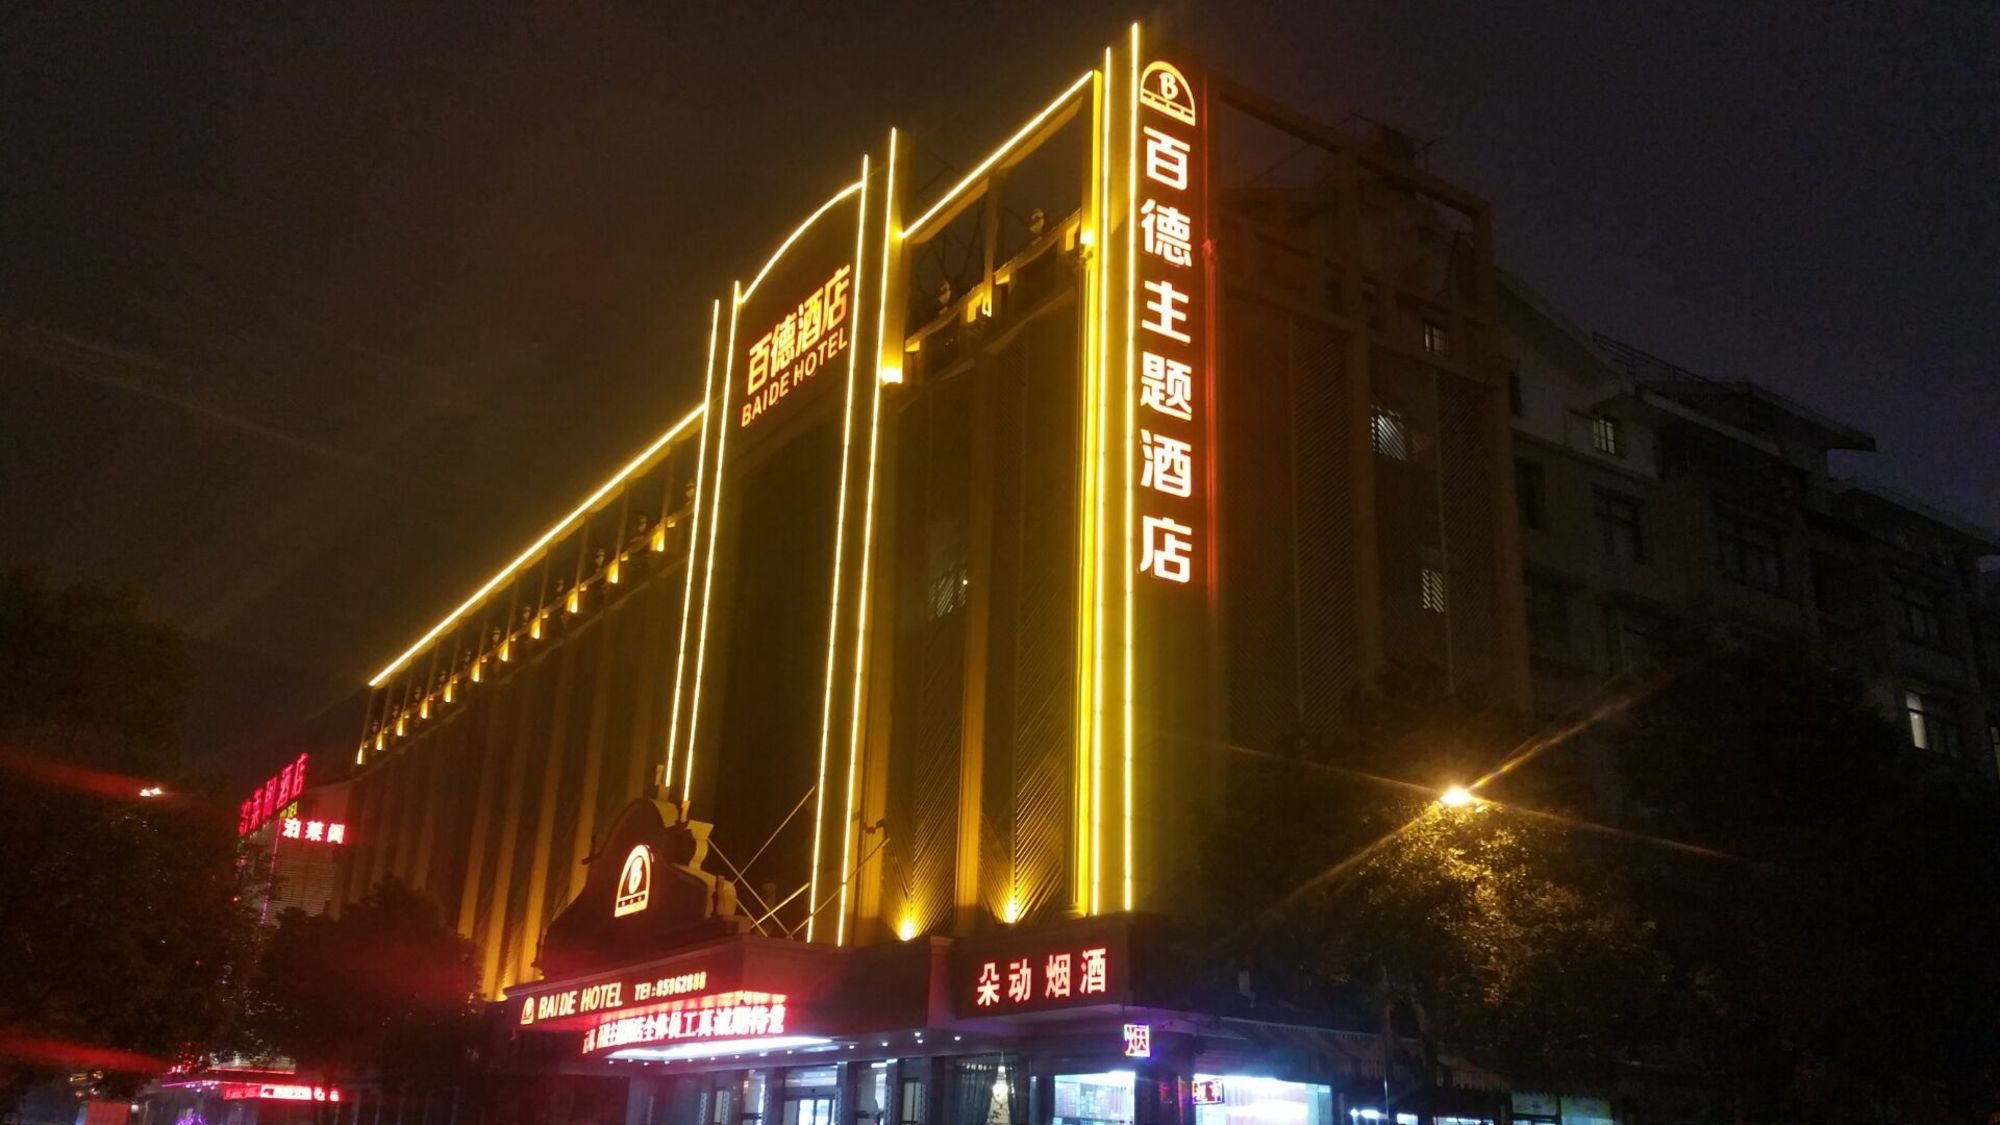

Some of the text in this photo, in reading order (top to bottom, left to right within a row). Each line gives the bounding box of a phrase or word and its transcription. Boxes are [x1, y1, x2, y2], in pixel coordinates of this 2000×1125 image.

[1159, 71, 1179, 101] B
[741, 327, 848, 428] BAIDE HOTEL
[747, 264, 851, 396] 百德酒店
[1140, 126, 1193, 583] 百德主题酒店
[537, 990, 578, 1020] BAIDE
[580, 981, 623, 1013] HOTEL
